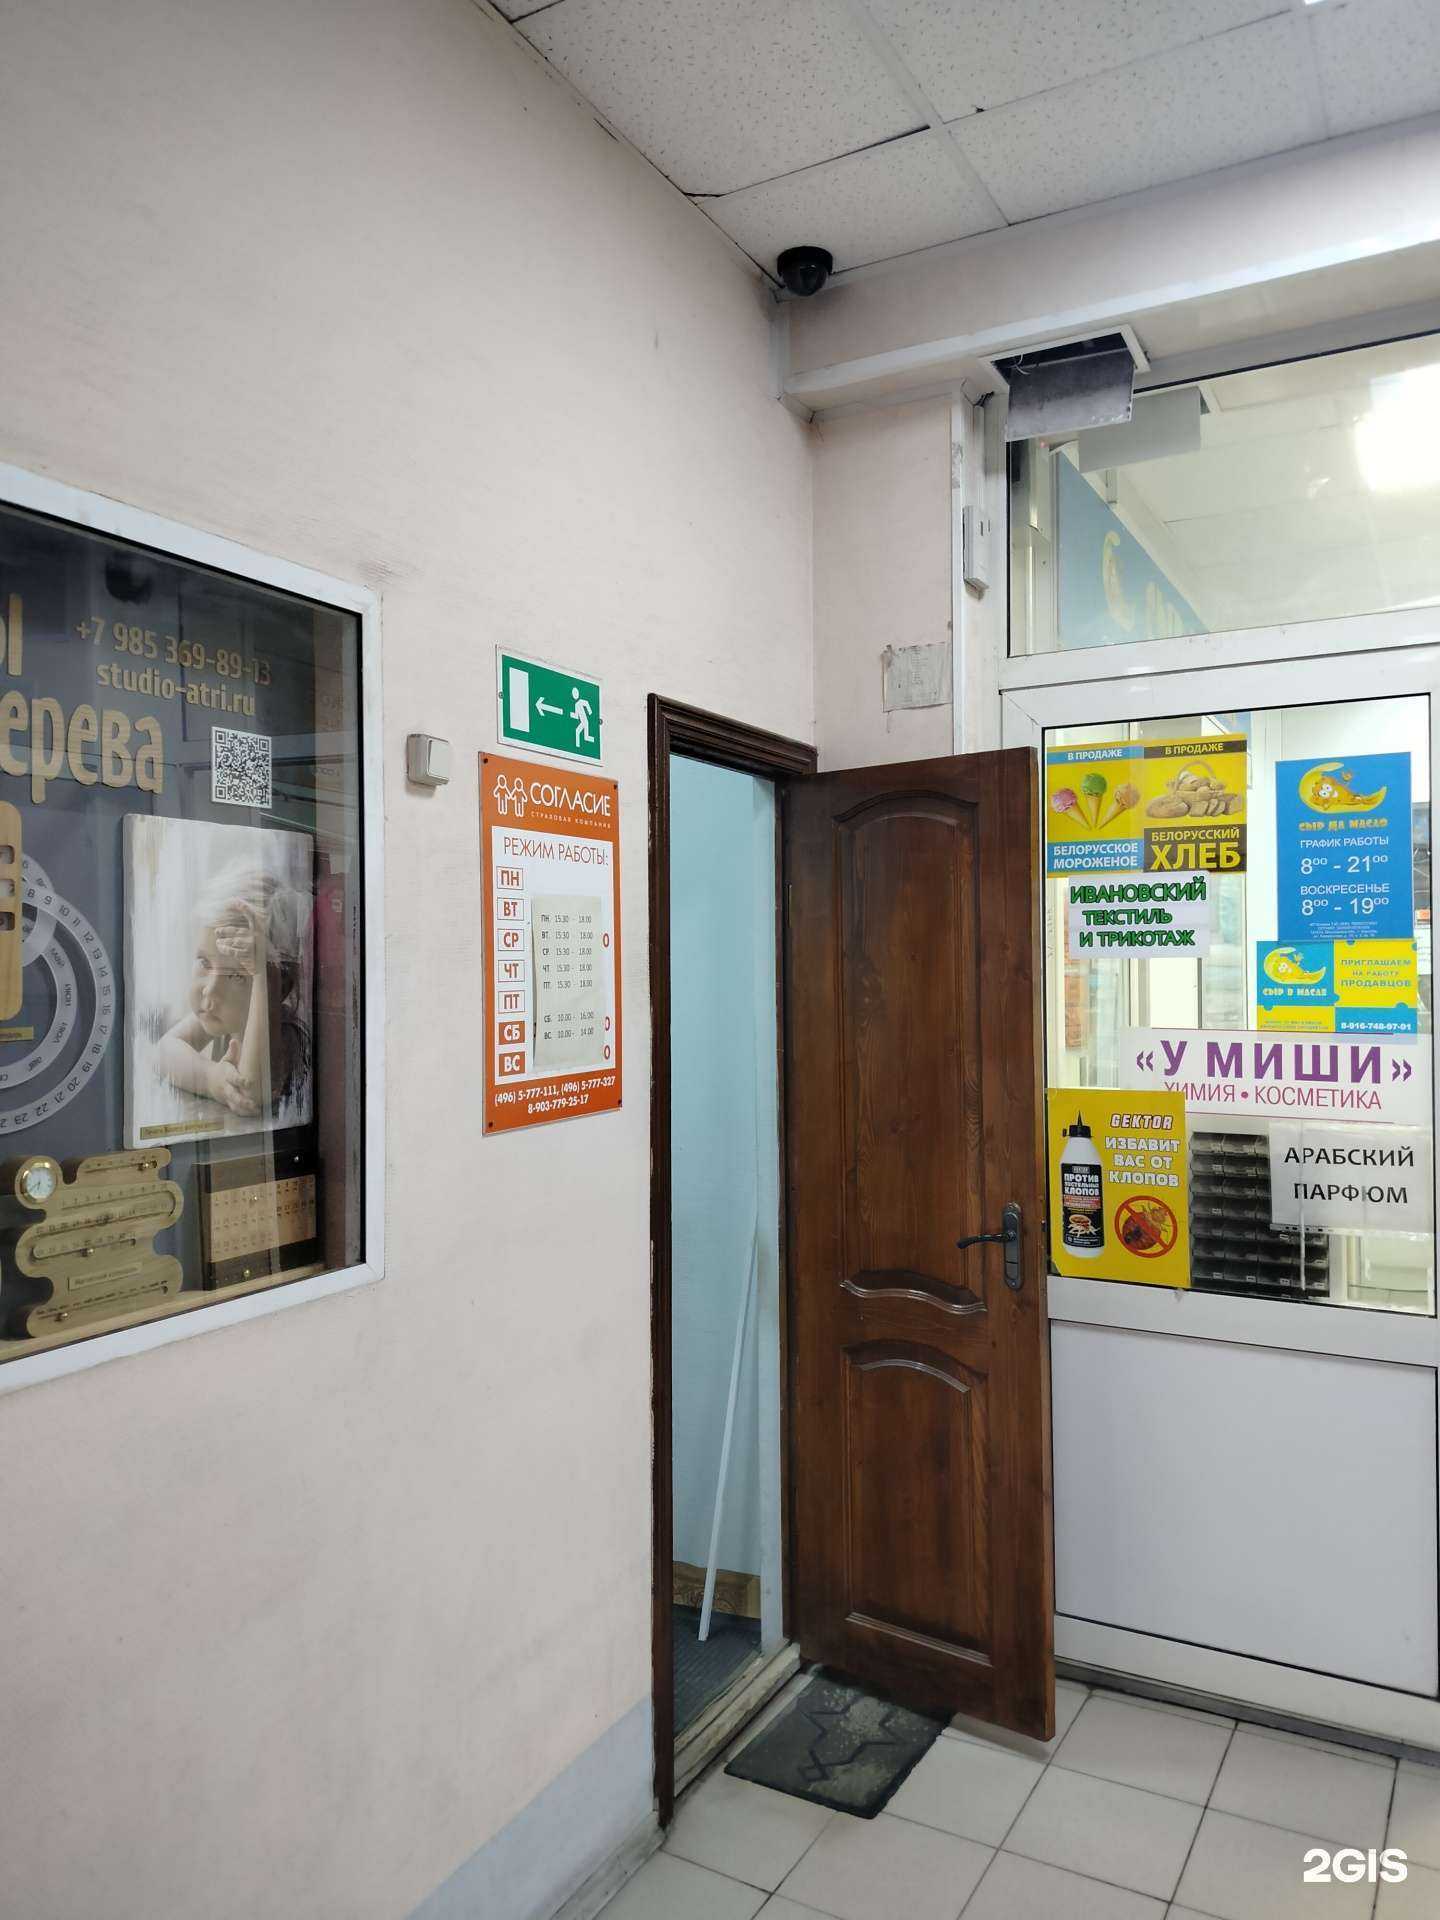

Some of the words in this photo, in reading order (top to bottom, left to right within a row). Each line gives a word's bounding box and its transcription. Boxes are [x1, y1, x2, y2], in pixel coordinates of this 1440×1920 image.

[76, 617, 105, 645] +7
[113, 622, 158, 660] 985
[164, 635, 272, 686] 369-89-13
[96, 663, 256, 716] studio-atri.ru
[1067, 752, 1074, 761] В
[1075, 749, 1123, 760] ПРОДАЖЕ
[1165, 746, 1171, 755] В
[1173, 742, 1224, 755] ПРОДАЖЕ
[530, 782, 611, 817] СОГЛАСИЕ
[1151, 826, 1240, 842] БЕЛОРУССКИЙ
[1298, 822, 1326, 832] СЫР
[1328, 820, 1345, 832] ДА
[504, 836, 554, 859] РЕЖИМ
[558, 843, 609, 866] РАБОТЫ:
[1053, 842, 1139, 856] БЕЛОРУССКОЕ
[1300, 838, 1341, 849] ГРАФИК
[1343, 836, 1389, 847] РАБОТЫ
[1053, 855, 1138, 869] МОРОЖЕНОЕ
[1150, 841, 1241, 871] ХЛЕБ
[500, 869, 520, 886] ПН
[1070, 876, 1207, 904] ИВАНОВСКИЙ
[1300, 883, 1391, 896] ВОСКРЕСЕНЬЕ
[503, 901, 518, 917] ВТ
[1082, 908, 1173, 925] ТЕКСТИЛЬ
[59, 905, 70, 916] 10
[83, 931, 95, 943] 12
[503, 932, 519, 948] СР
[1079, 932, 1094, 947] И
[1097, 929, 1195, 947] ТРИКОТАЖ
[504, 963, 519, 979] ЧТ
[1341, 958, 1412, 967] ПРИГЛАШАЕМ
[1341, 979, 1411, 988] ПРОДАВЦОВ
[503, 994, 520, 1010] ПТ
[503, 1024, 521, 1041] СБ
[504, 1054, 521, 1072] ВС
[1136, 1040, 1188, 1076] «У
[1206, 1041, 1412, 1084] МИШИ»
[495, 1091, 516, 1107] (496)
[518, 1085, 559, 1101] 5-777-111,
[561, 1080, 580, 1096] (496)
[581, 1076, 616, 1090] 5-777-327
[1255, 1085, 1382, 1110] КОСМЕТИКА
[527, 1094, 590, 1114] 8-903-779-25-17
[1110, 1113, 1174, 1130] GEKTOR
[1105, 1136, 1180, 1153] ИЗБАВИТ
[1113, 1154, 1145, 1168] ВАС
[1150, 1155, 1174, 1169] ОТ
[1284, 1146, 1415, 1168] АРАБСКИЙ
[1063, 1173, 1099, 1183] ПРОТИВ
[1108, 1170, 1180, 1187] КЛОПОВ
[1064, 1187, 1100, 1196] КЛОПОВ
[1293, 1183, 1408, 1204] ПАРФЮМ
